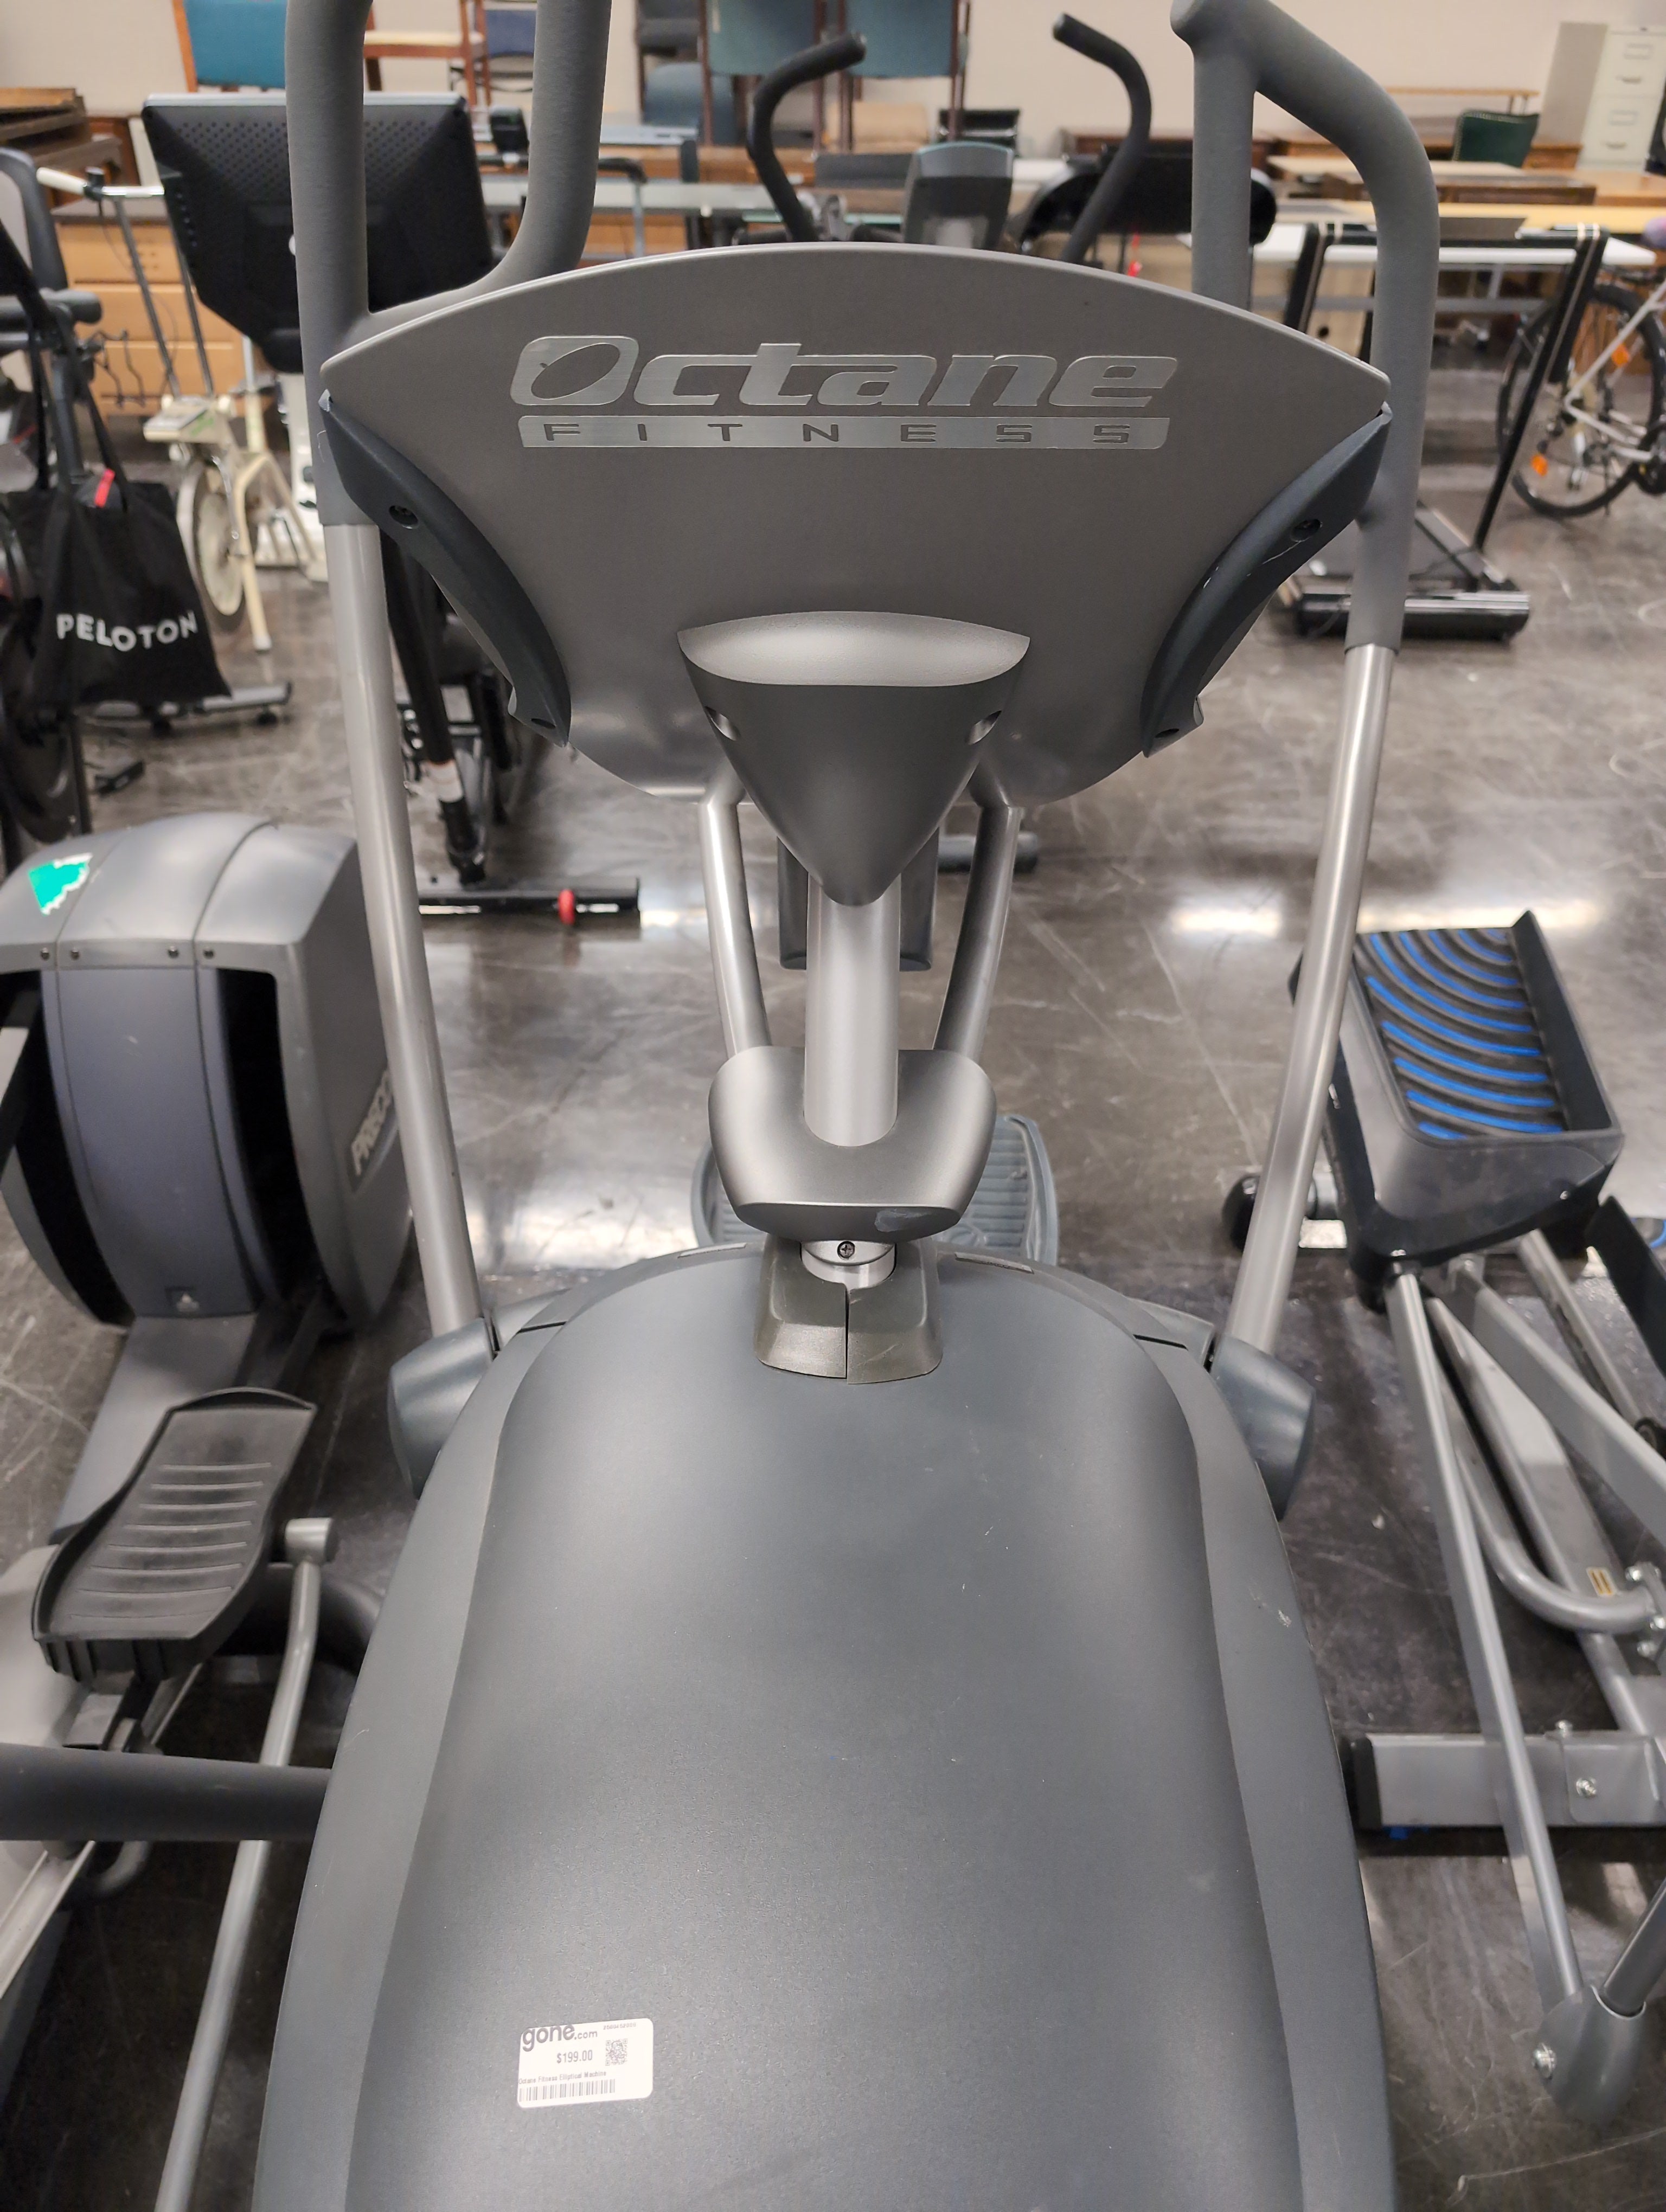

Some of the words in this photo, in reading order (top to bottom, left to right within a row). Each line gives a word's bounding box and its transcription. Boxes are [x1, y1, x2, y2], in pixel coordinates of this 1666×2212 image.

[510, 335, 1177, 407] Octane
[543, 423, 1130, 445] FITNESS
[56, 609, 198, 652] PELOTON
[522, 2024, 598, 2052] gone.com
[556, 2049, 593, 2064] $199.00
[559, 2073, 582, 2081] Elliptical
